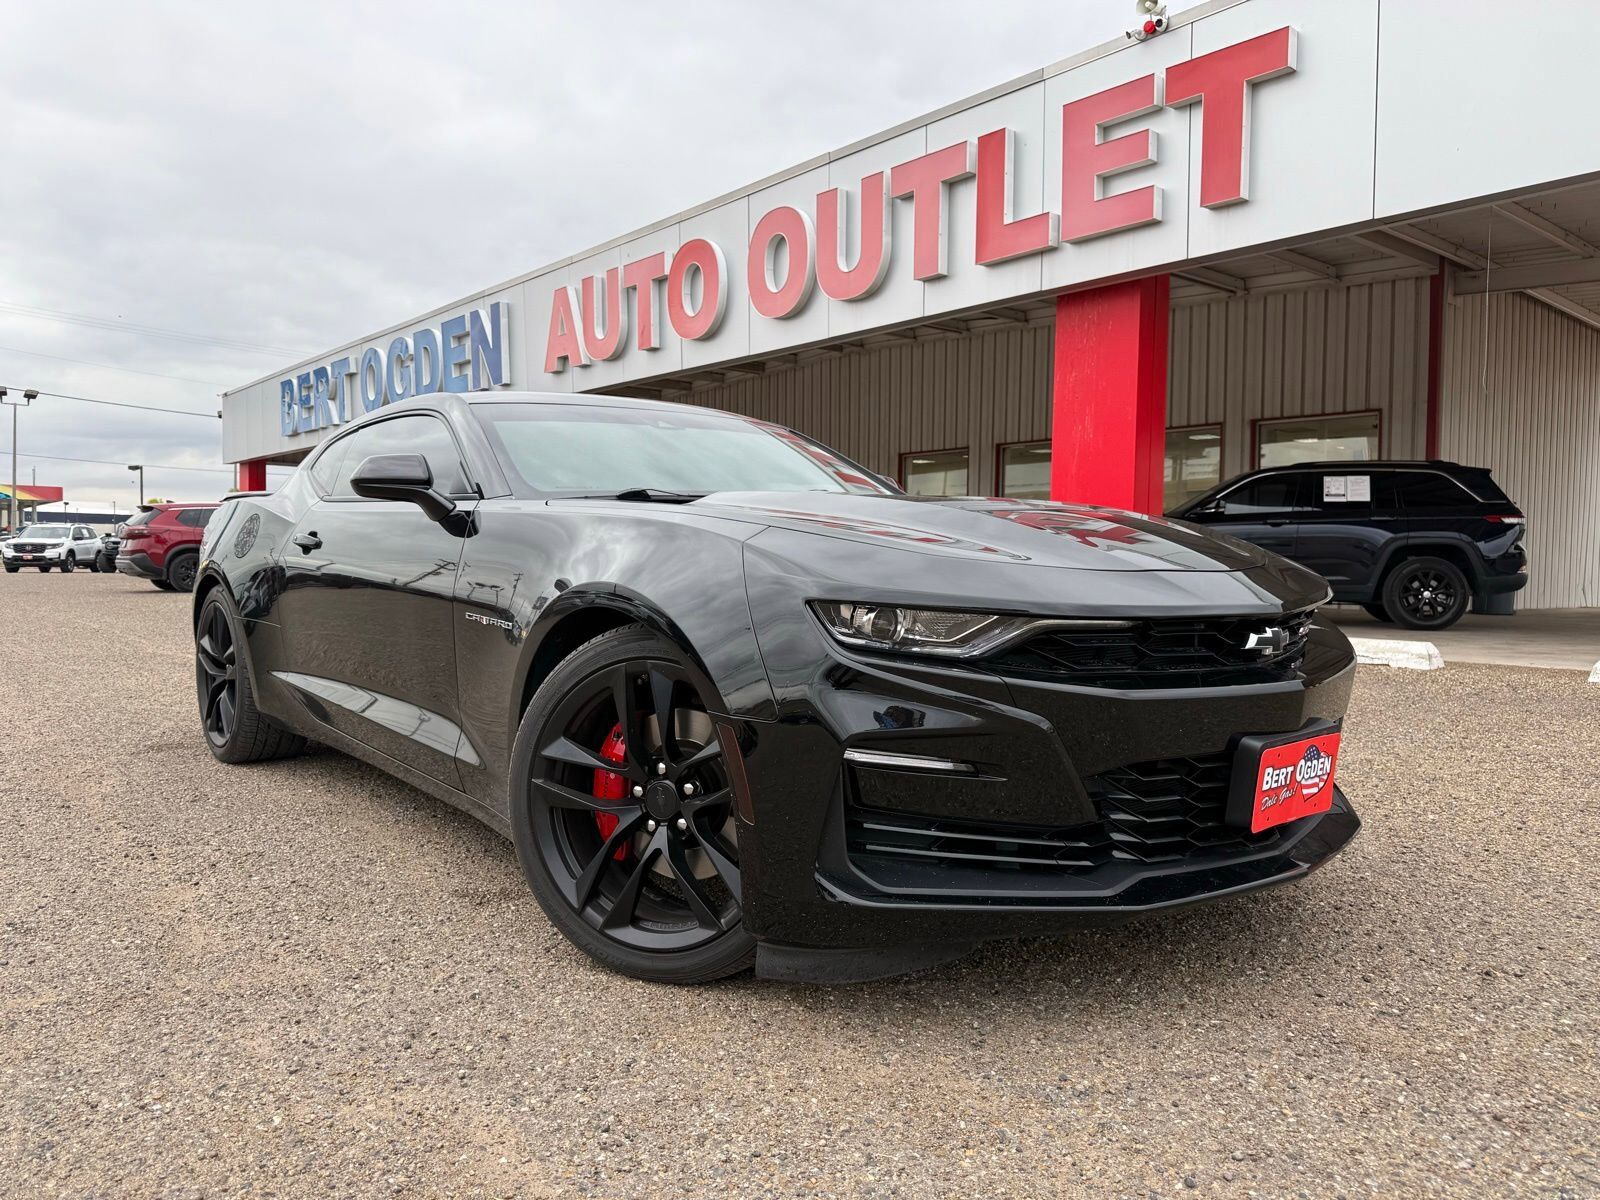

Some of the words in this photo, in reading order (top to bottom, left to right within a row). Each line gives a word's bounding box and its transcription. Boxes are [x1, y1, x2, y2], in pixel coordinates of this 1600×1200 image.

[280, 356, 357, 437] BERT
[360, 301, 510, 414] OGDEN
[544, 238, 728, 374] AUTO
[747, 25, 1298, 320] OUTLET
[1262, 766, 1294, 791] BERT
[1296, 756, 1332, 783] OGDEN
